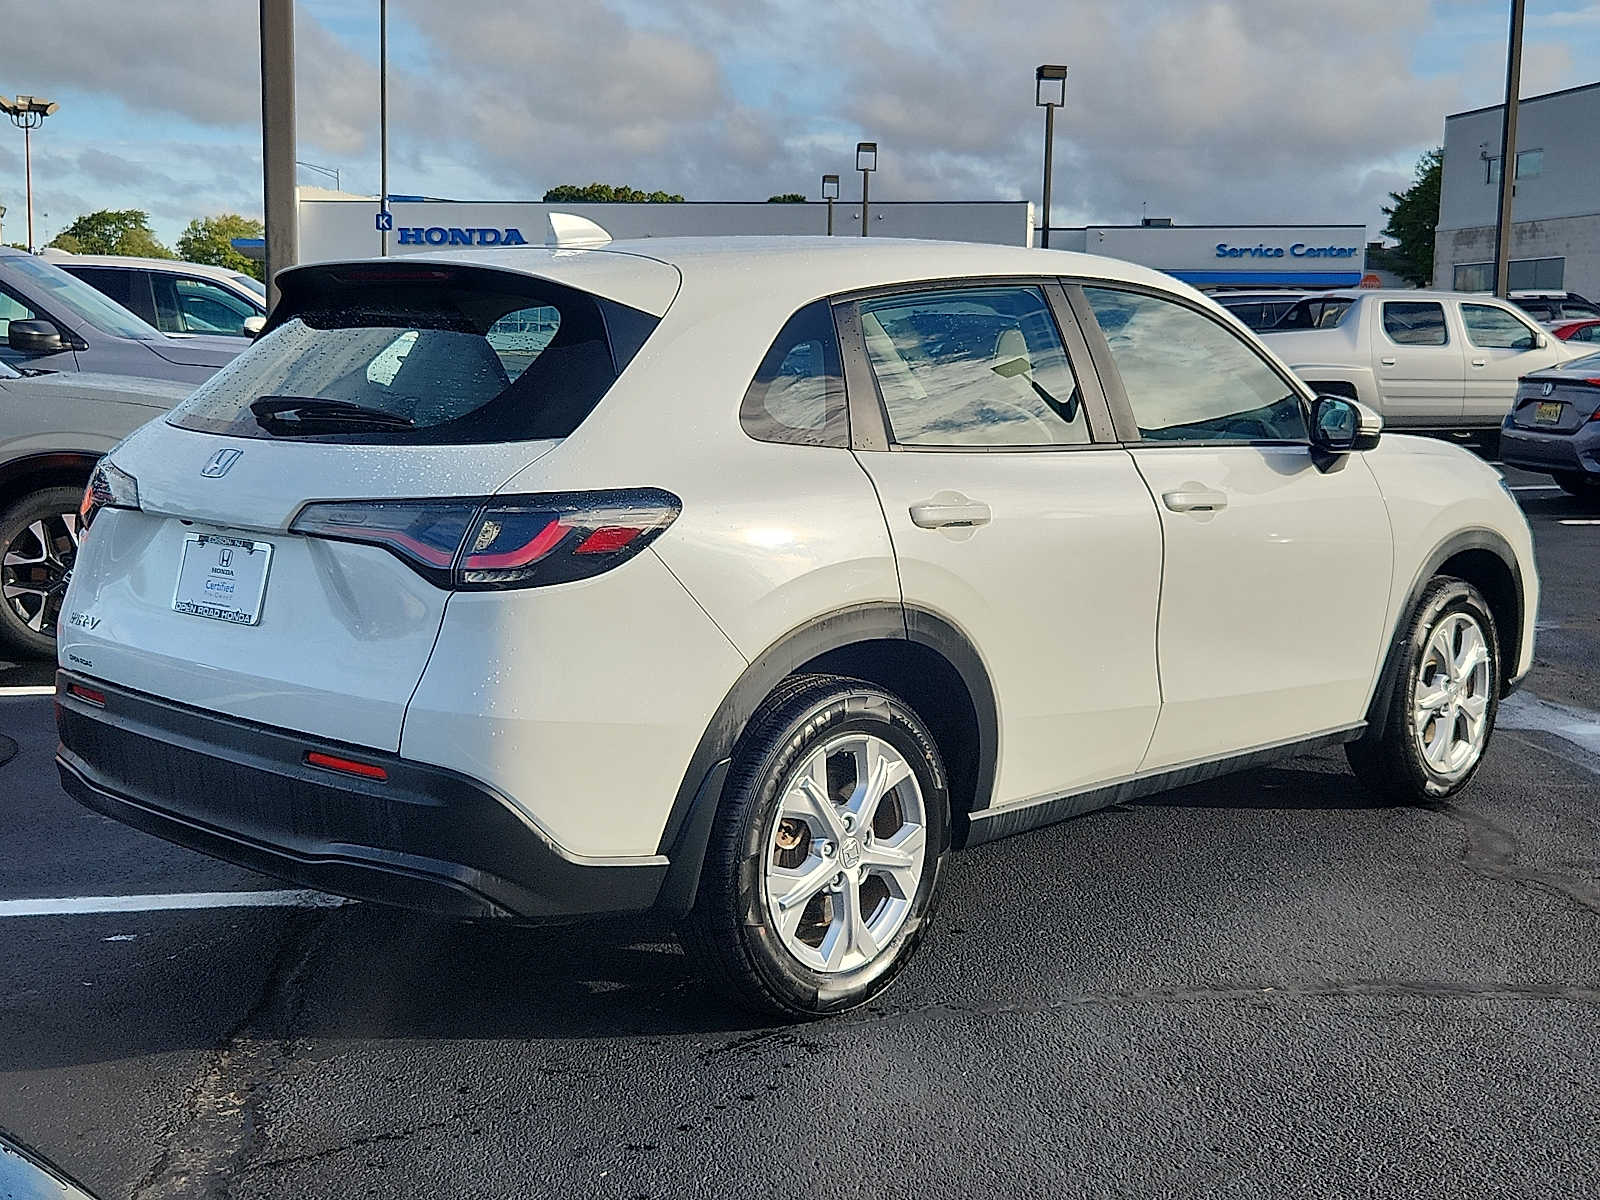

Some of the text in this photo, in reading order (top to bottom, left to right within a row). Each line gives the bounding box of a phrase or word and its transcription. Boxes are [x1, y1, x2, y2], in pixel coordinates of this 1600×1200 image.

[379, 215, 389, 228] K
[398, 227, 528, 245] HONDA
[1215, 243, 1357, 258] Service Center
[211, 567, 234, 576] HONDA
[205, 580, 235, 593] Certified
[175, 602, 198, 614] OPEN
[199, 605, 220, 618] ROAD
[221, 610, 252, 623] HONDA
[69, 612, 101, 630] HR-V
